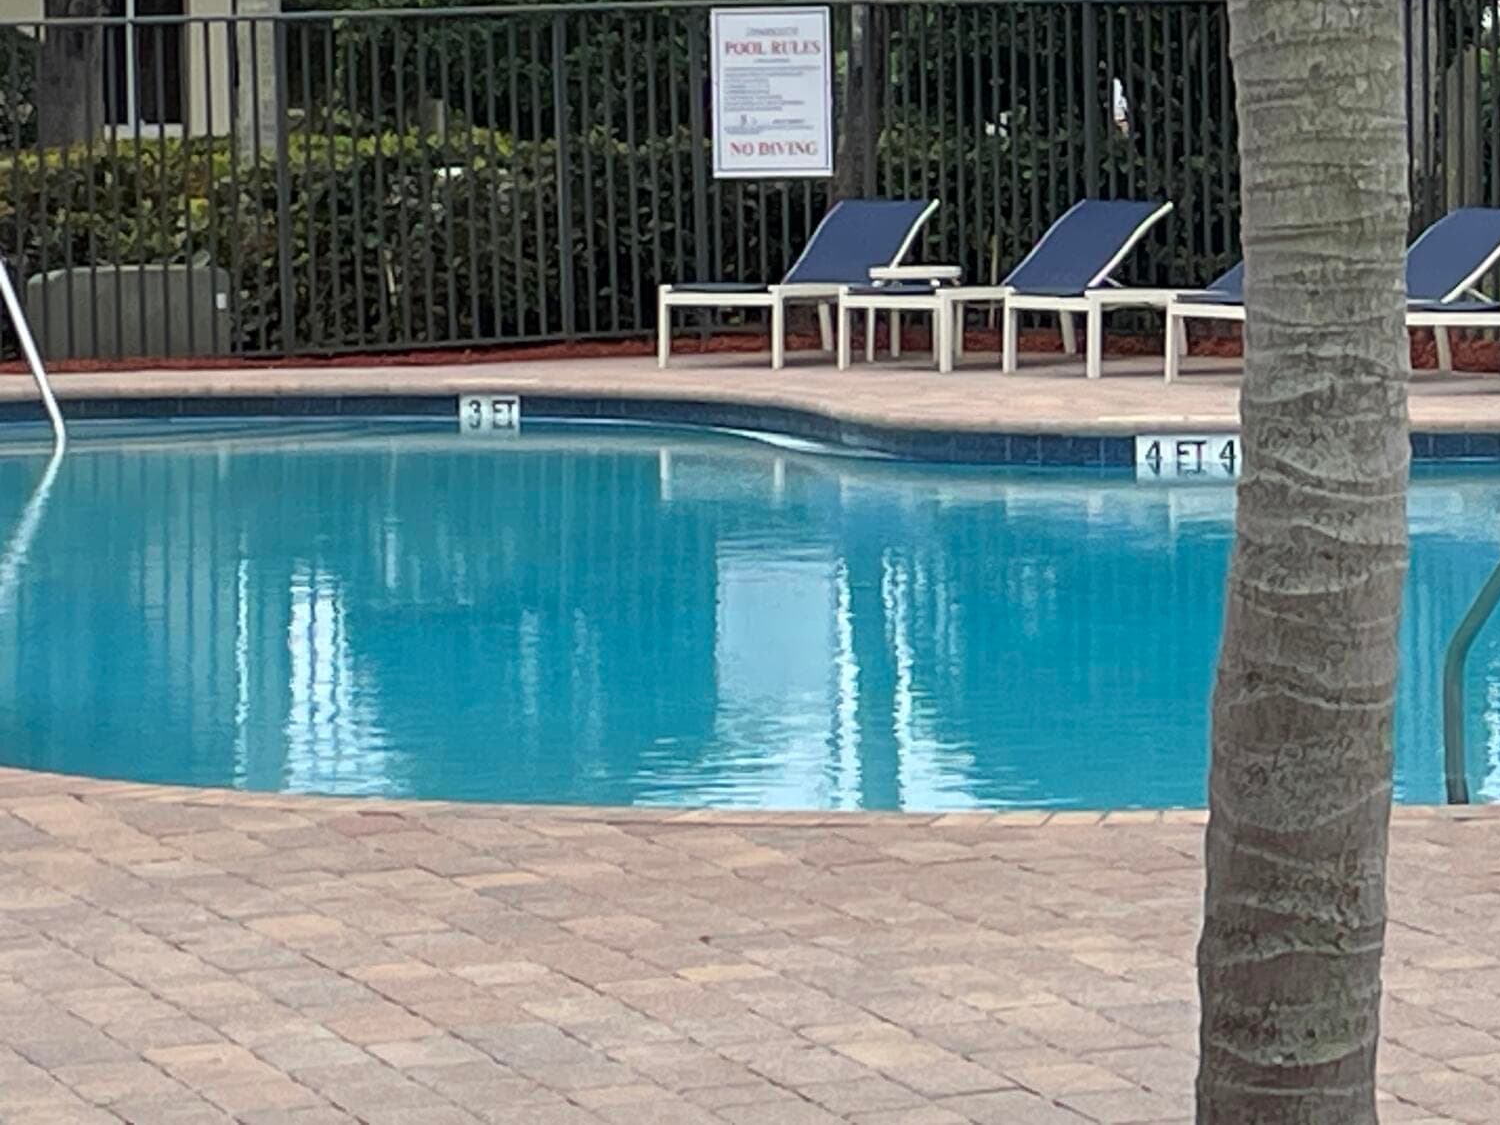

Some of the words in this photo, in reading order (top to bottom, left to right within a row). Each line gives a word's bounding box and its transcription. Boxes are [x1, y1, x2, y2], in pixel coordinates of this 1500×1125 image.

[725, 41, 767, 55] POOL
[771, 40, 821, 55] RULES
[729, 142, 754, 156] NO
[758, 142, 818, 156] DIVING
[469, 400, 482, 421] 3
[492, 400, 516, 421] FT
[1145, 440, 1162, 467] 4
[1176, 440, 1207, 467] FT
[1219, 440, 1237, 467] 4
